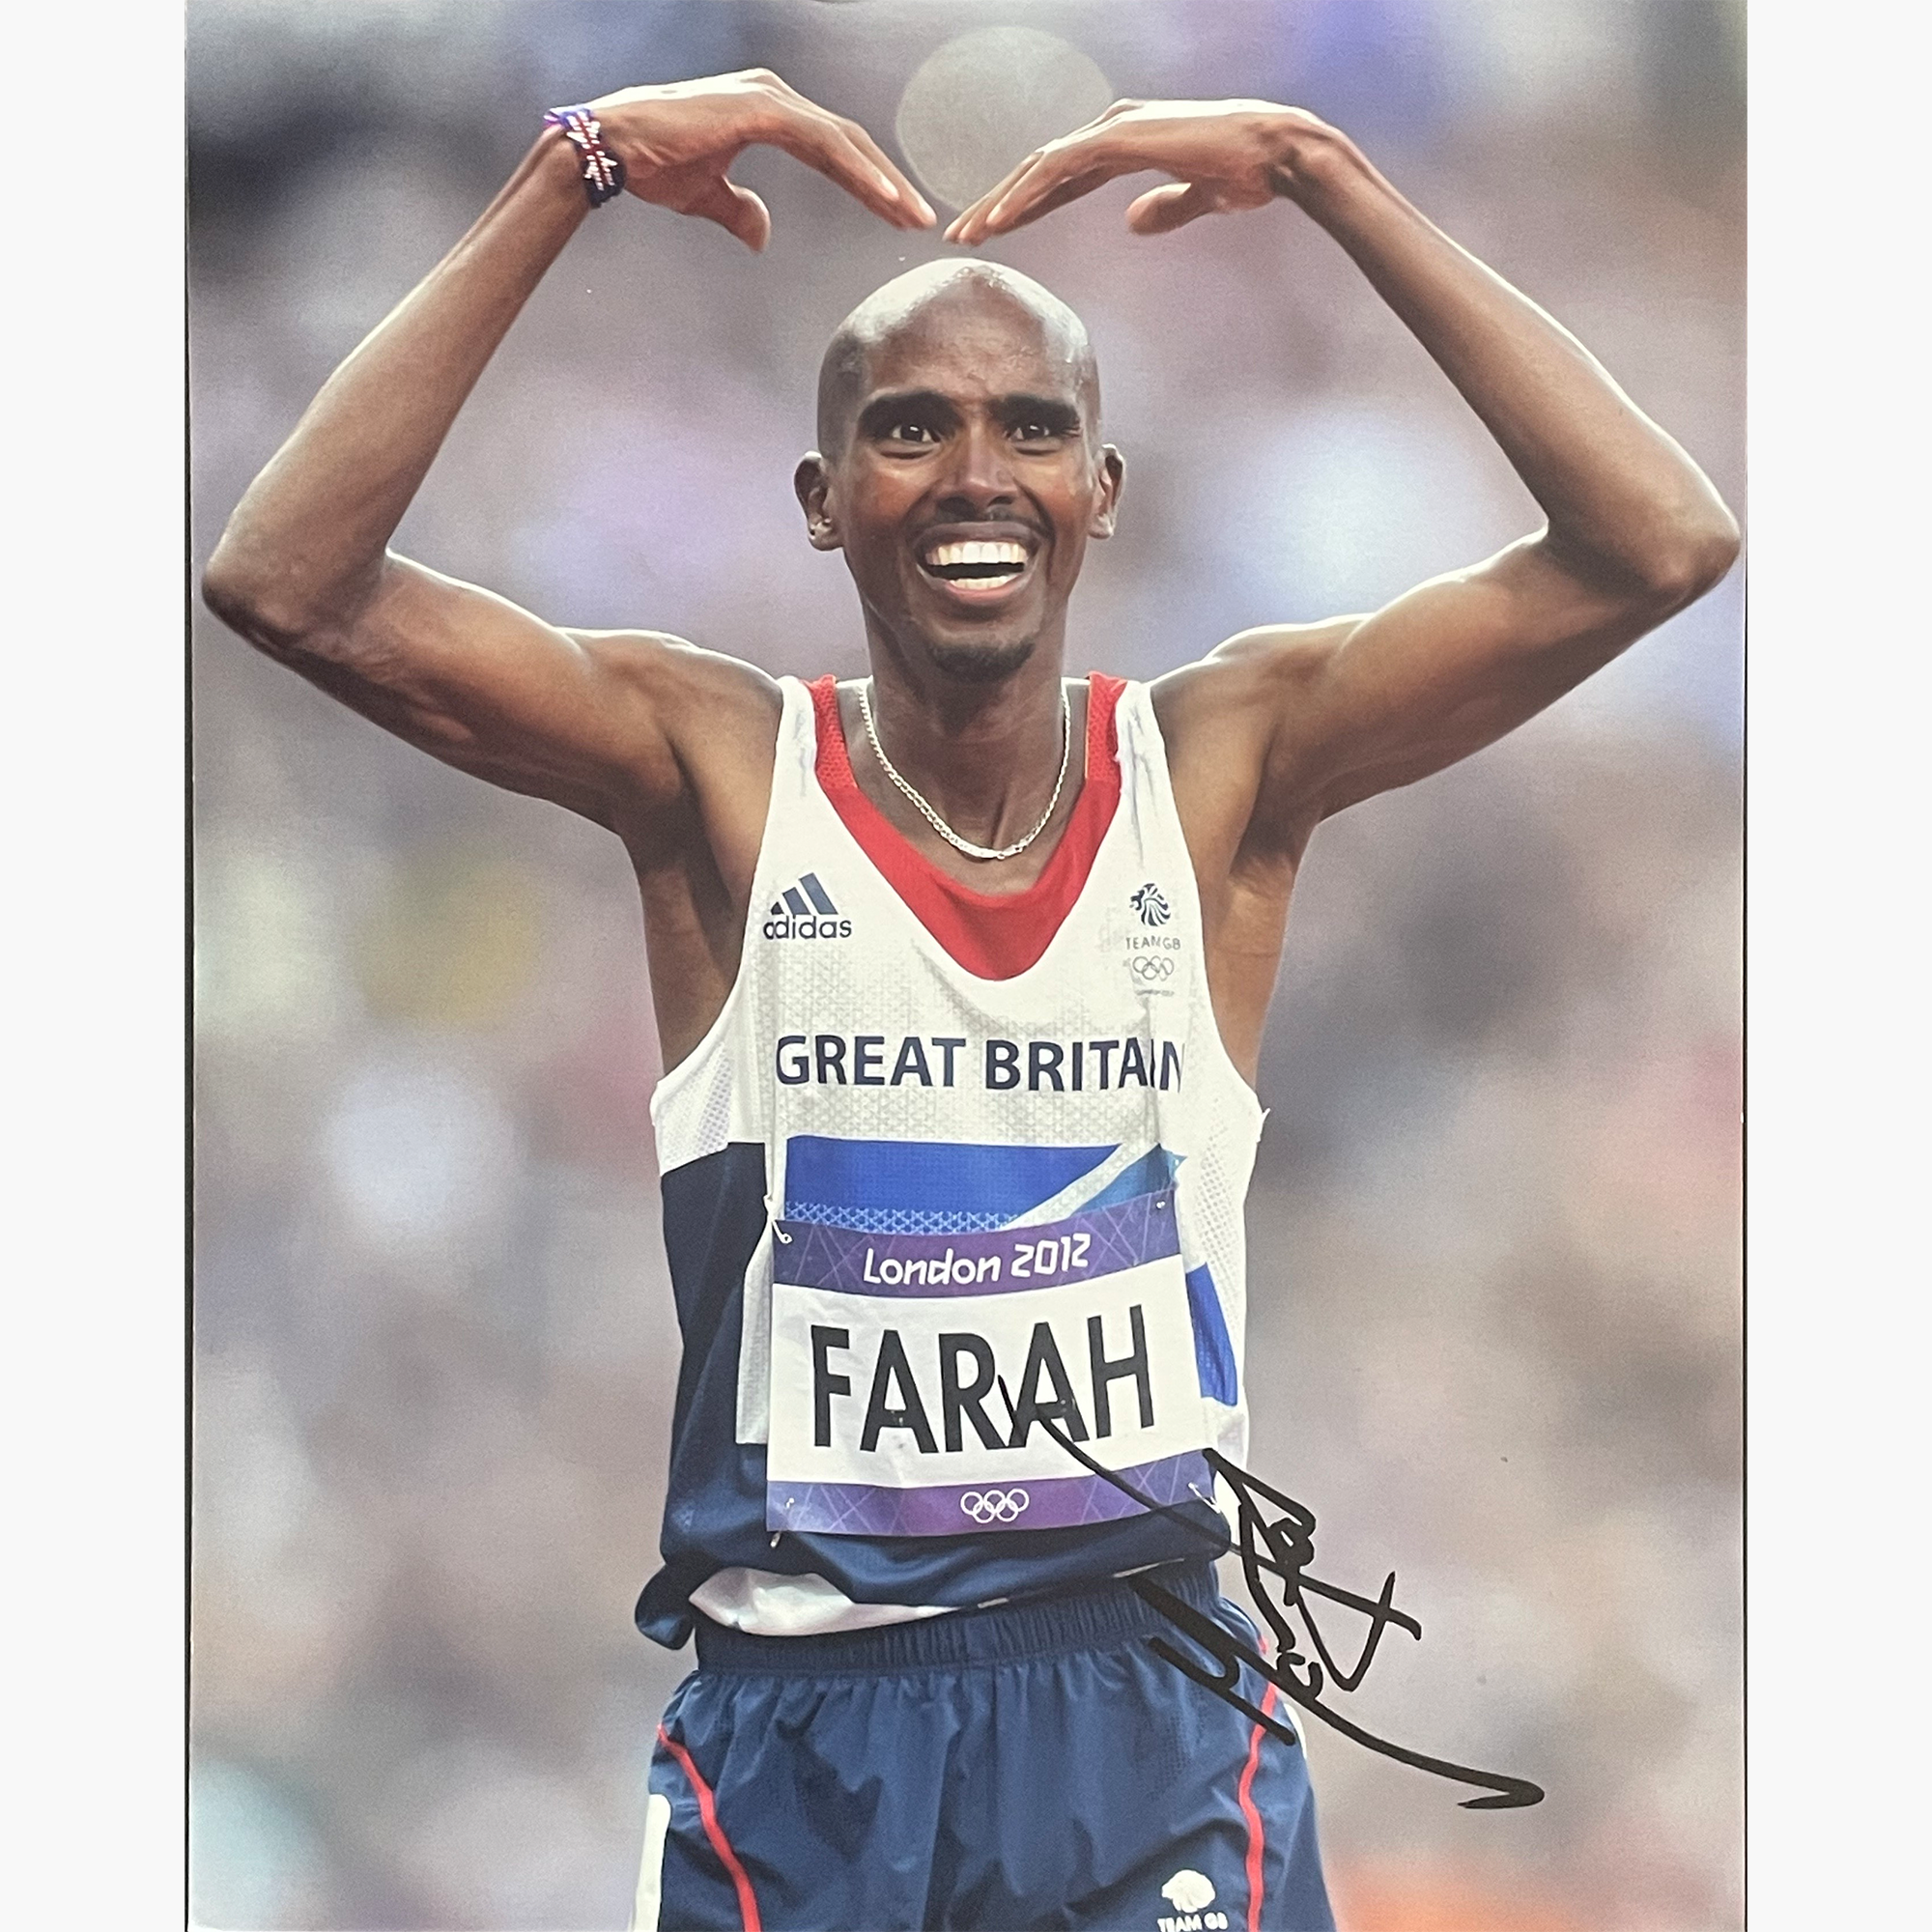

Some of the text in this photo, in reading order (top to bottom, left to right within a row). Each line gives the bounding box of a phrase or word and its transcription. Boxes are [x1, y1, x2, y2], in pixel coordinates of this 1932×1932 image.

[762, 915, 852, 940] adidas
[775, 1034, 1186, 1093] GREAT BRITAIN
[863, 1233, 1092, 1286] London 2012
[810, 1303, 1154, 1454] FARAH
